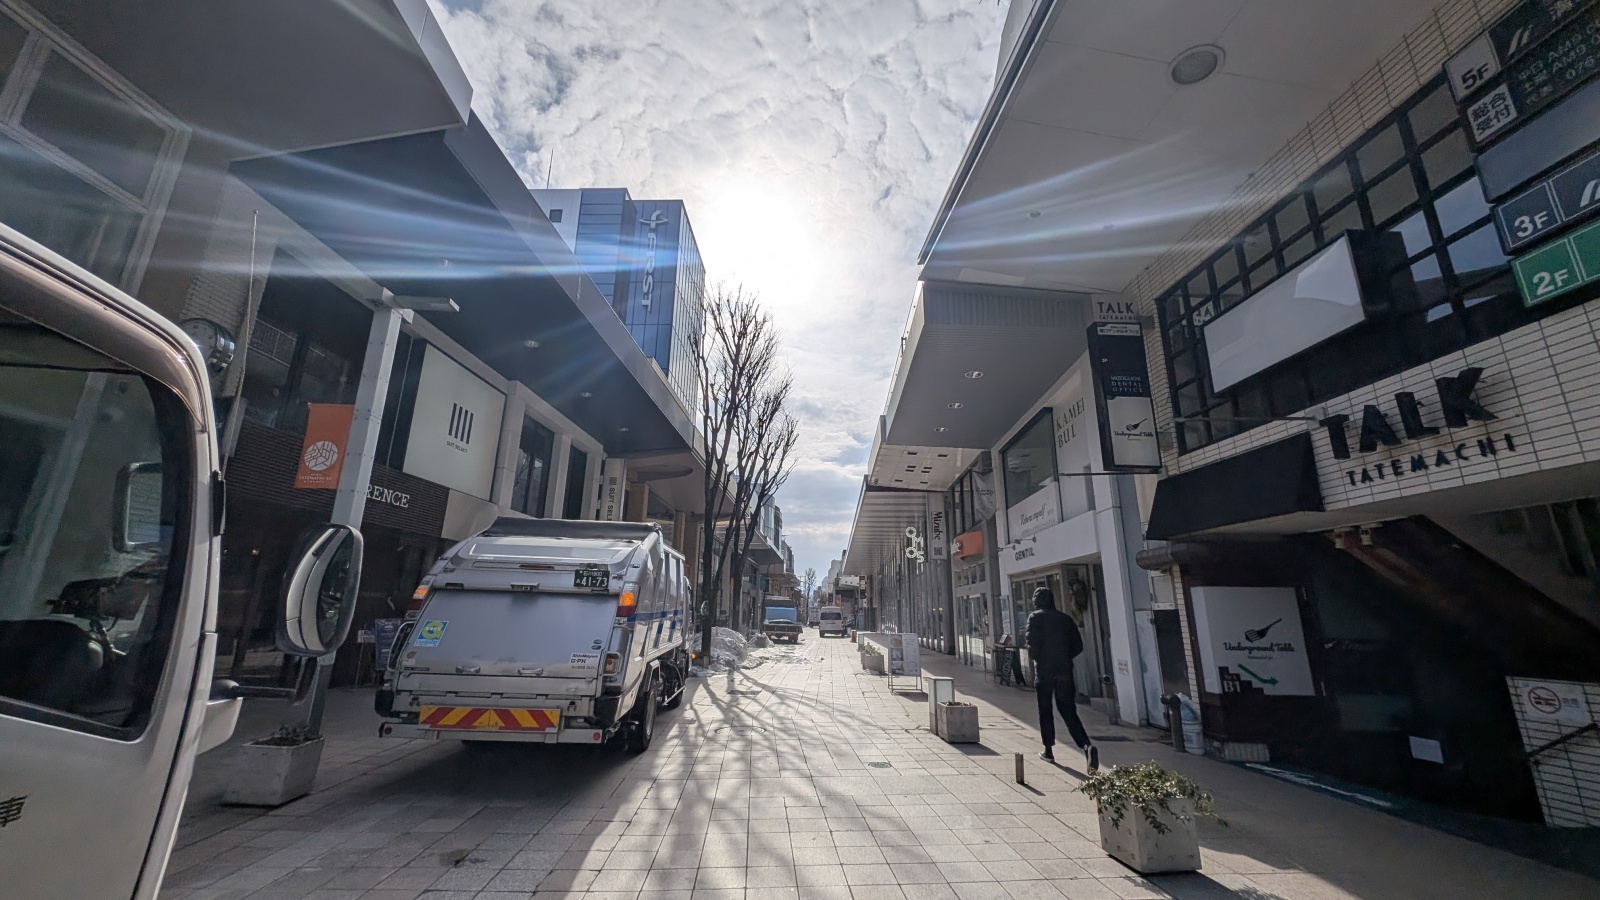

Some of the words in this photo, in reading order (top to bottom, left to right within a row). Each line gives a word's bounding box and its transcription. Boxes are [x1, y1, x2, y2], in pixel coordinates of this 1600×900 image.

[1461, 62, 1490, 90] 5F
[1475, 104, 1512, 136] 受付
[1514, 210, 1550, 238] 3F
[1532, 268, 1569, 296] 2F
[1097, 301, 1134, 314] TALK
[1056, 397, 1085, 432] KAMEI
[1319, 367, 1499, 460] TALK
[1345, 433, 1516, 486] TATEMACHI
[608, 487, 616, 503] SUIT
[933, 511, 944, 540] Mizube
[581, 576, 608, 587] 41-73
[1223, 642, 1275, 655] Underground
[1275, 642, 1295, 652] Table
[1223, 680, 1241, 693] B1
